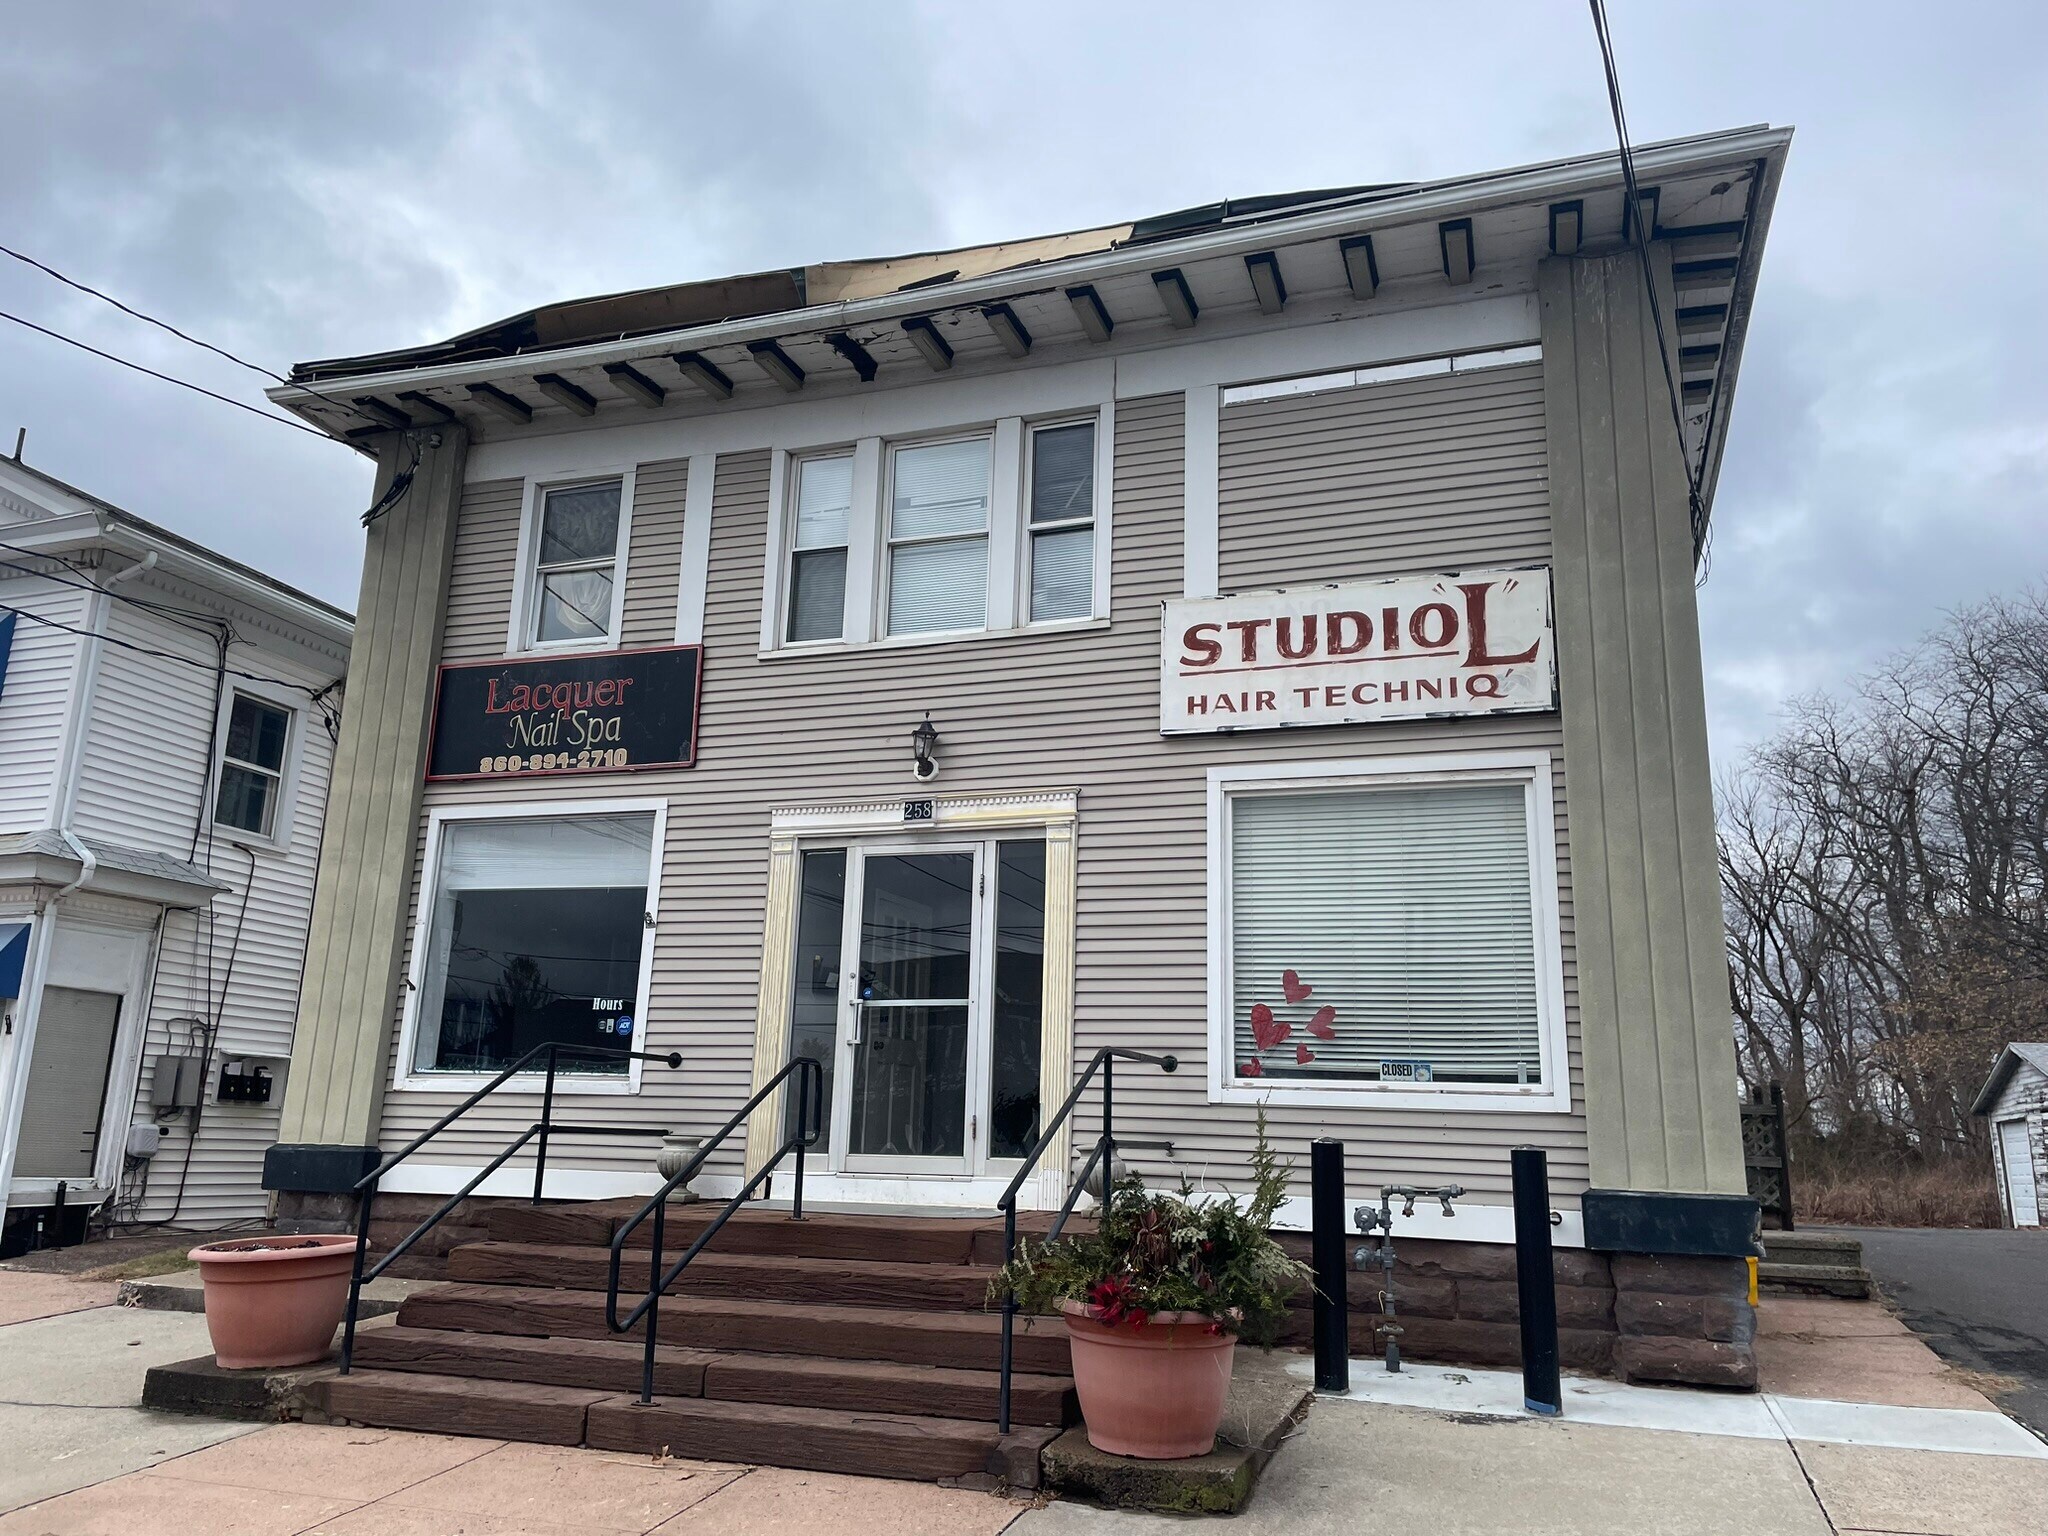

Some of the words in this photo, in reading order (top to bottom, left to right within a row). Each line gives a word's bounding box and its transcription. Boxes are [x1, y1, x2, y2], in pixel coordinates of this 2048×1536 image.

[1178, 603, 1460, 667] STUDIO
[484, 676, 634, 720] Lacquer
[1187, 690, 1277, 717] HAIR
[506, 708, 564, 749] Nail
[566, 709, 622, 750] Spa
[479, 748, 628, 773] 860-894-2710
[904, 801, 931, 819] 258
[592, 997, 623, 1011] Hours
[1381, 1063, 1413, 1077] CLOSED
